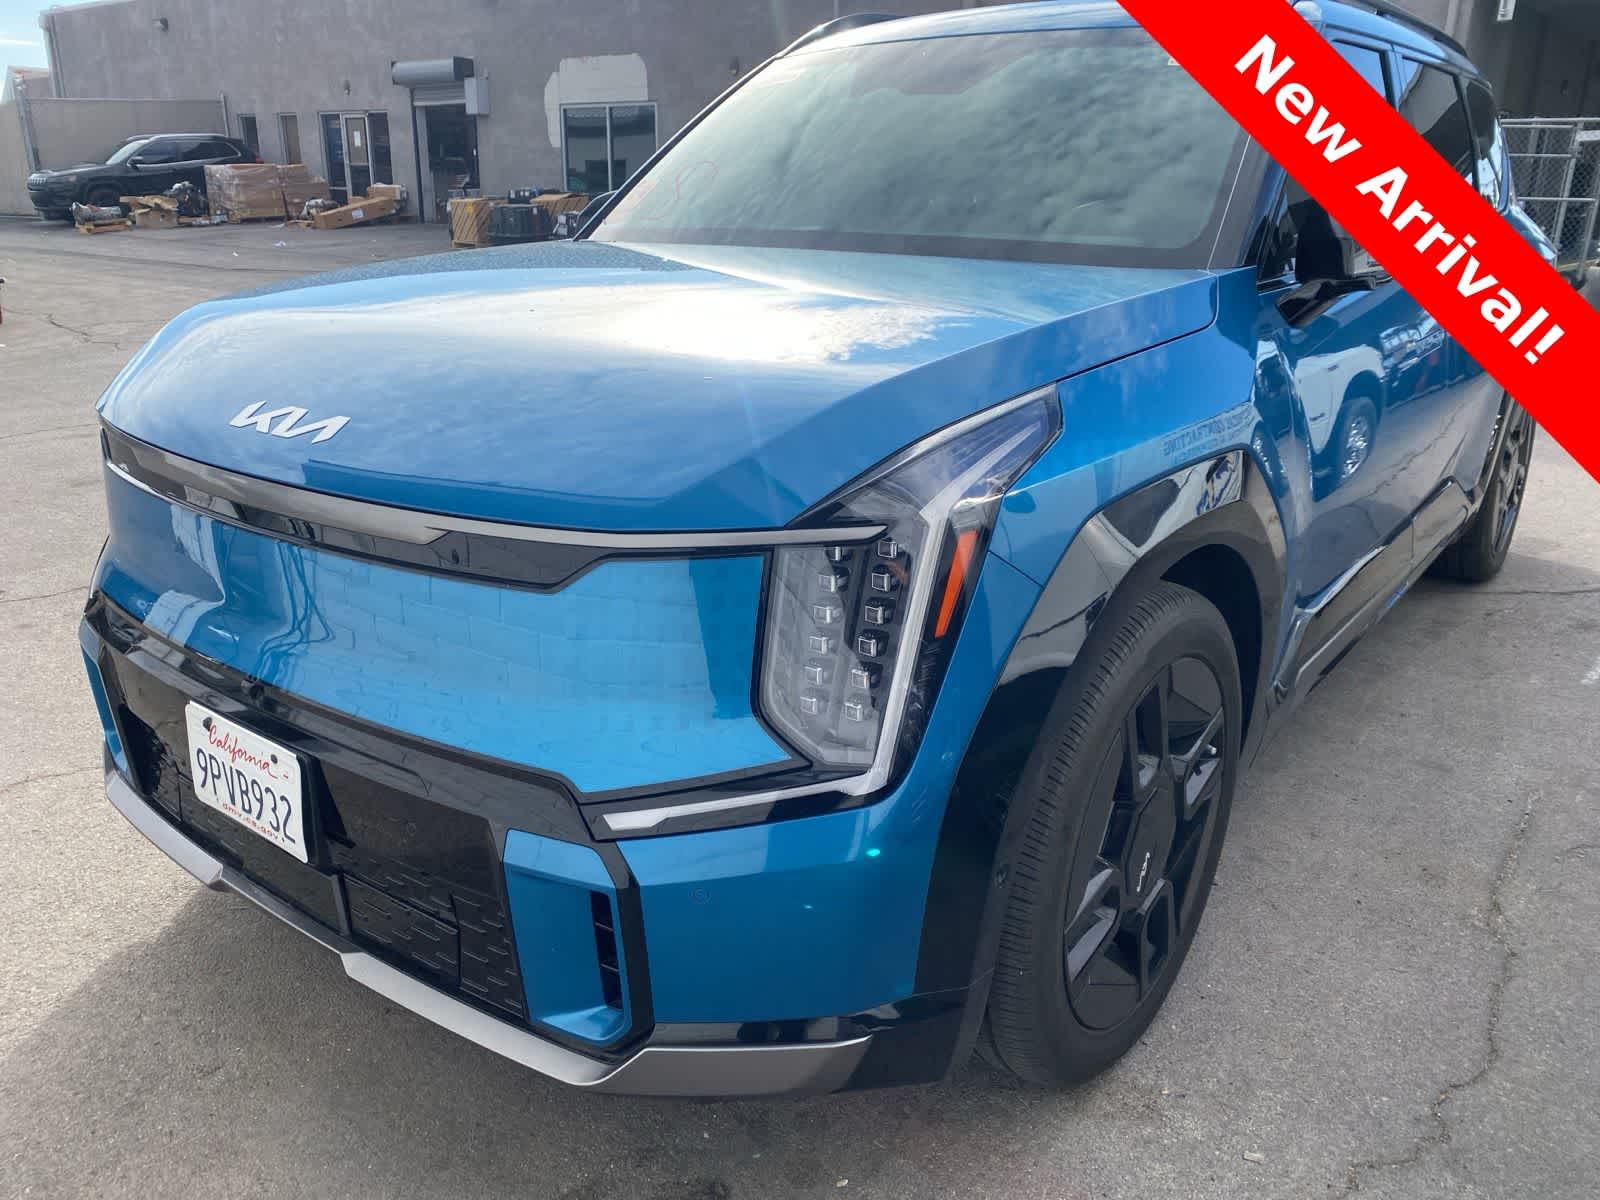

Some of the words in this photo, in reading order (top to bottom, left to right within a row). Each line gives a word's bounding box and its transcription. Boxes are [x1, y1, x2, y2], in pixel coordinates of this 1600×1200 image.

[229, 400, 351, 445] KIA
[207, 724, 278, 779] California
[196, 747, 296, 844] 9PVB932
